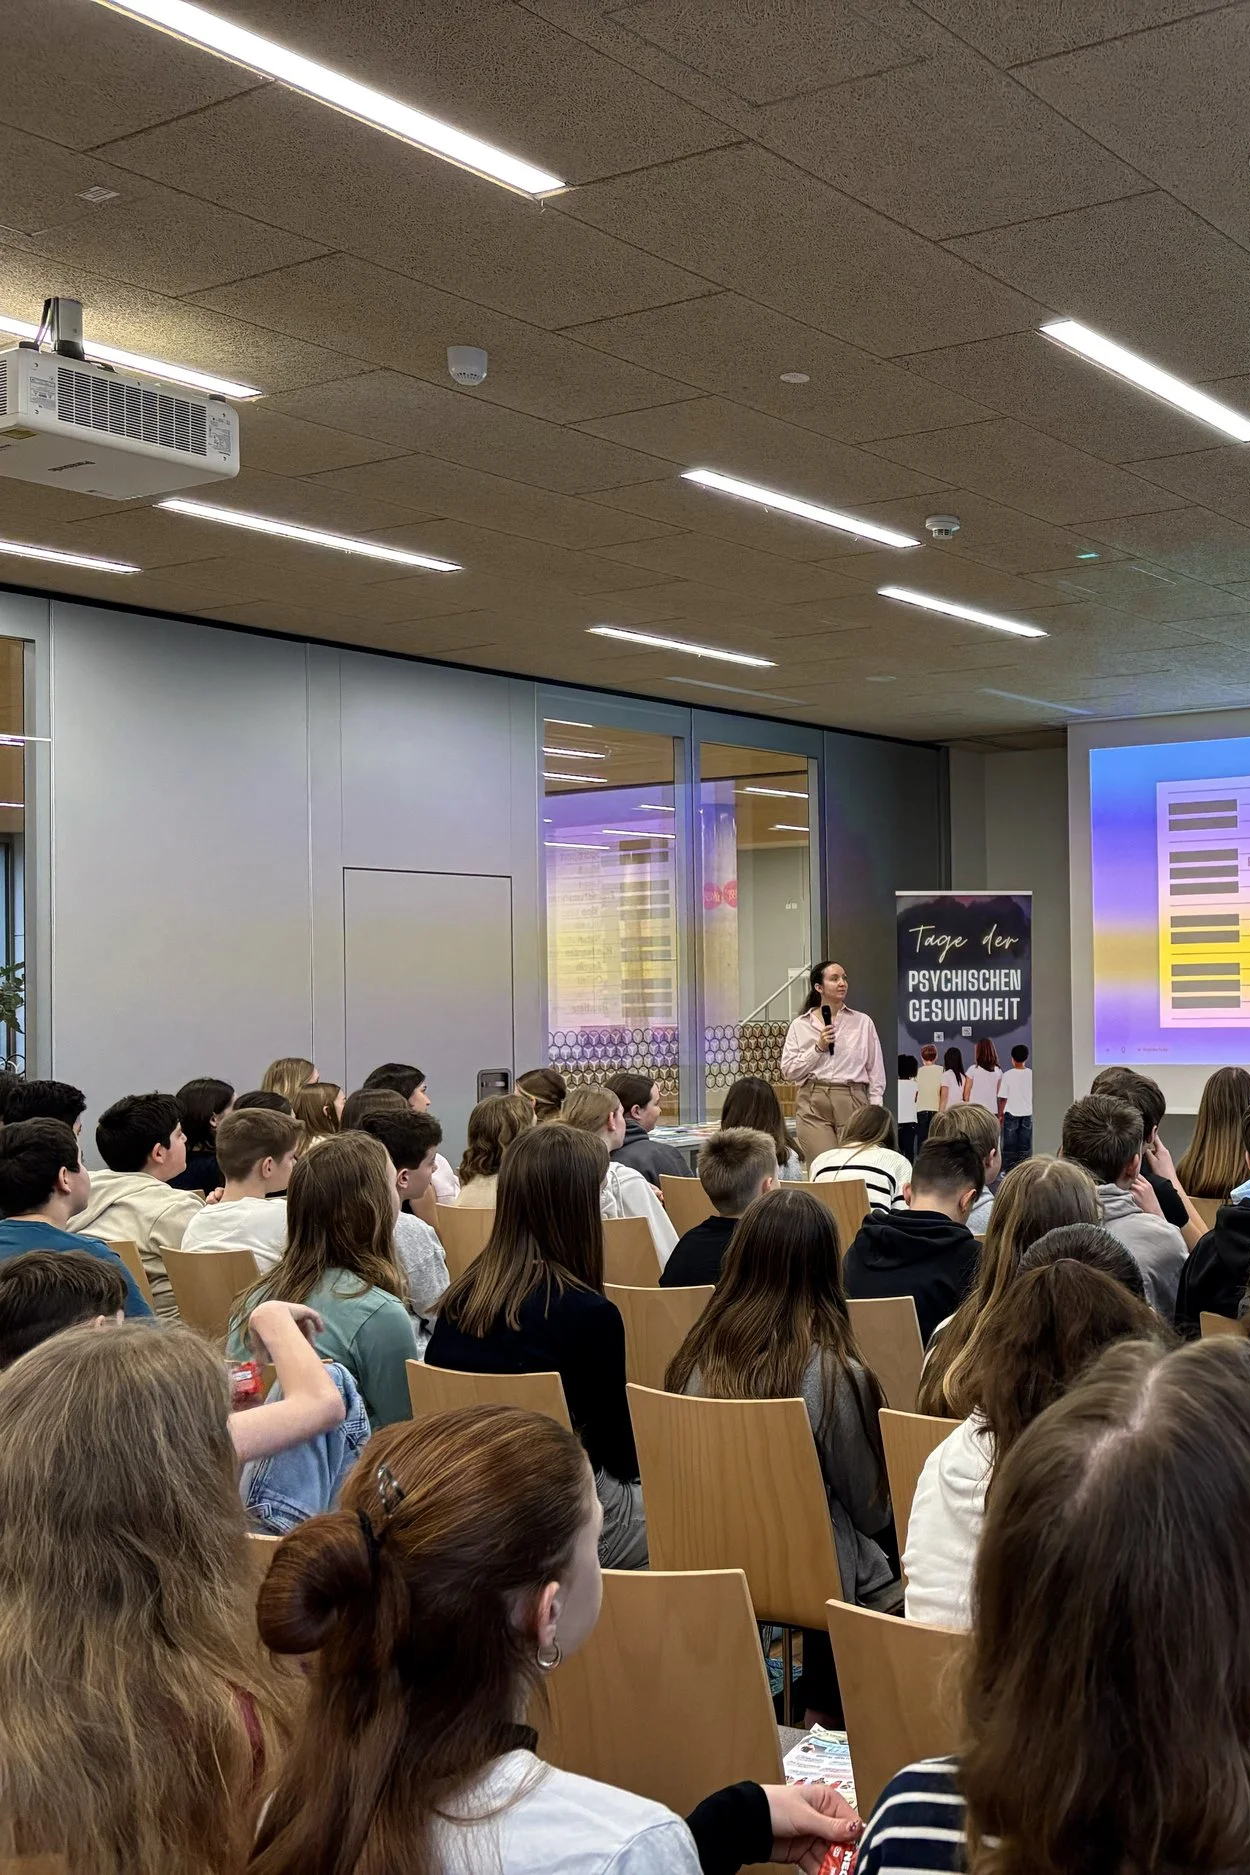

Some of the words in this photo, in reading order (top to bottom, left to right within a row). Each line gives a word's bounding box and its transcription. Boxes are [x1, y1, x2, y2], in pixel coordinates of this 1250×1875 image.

[908, 924, 968, 964] Tage
[982, 923, 1020, 955] der
[908, 969, 1021, 992] PSYCHISCHEN
[908, 997, 1021, 1022] GESUNDHEIT
